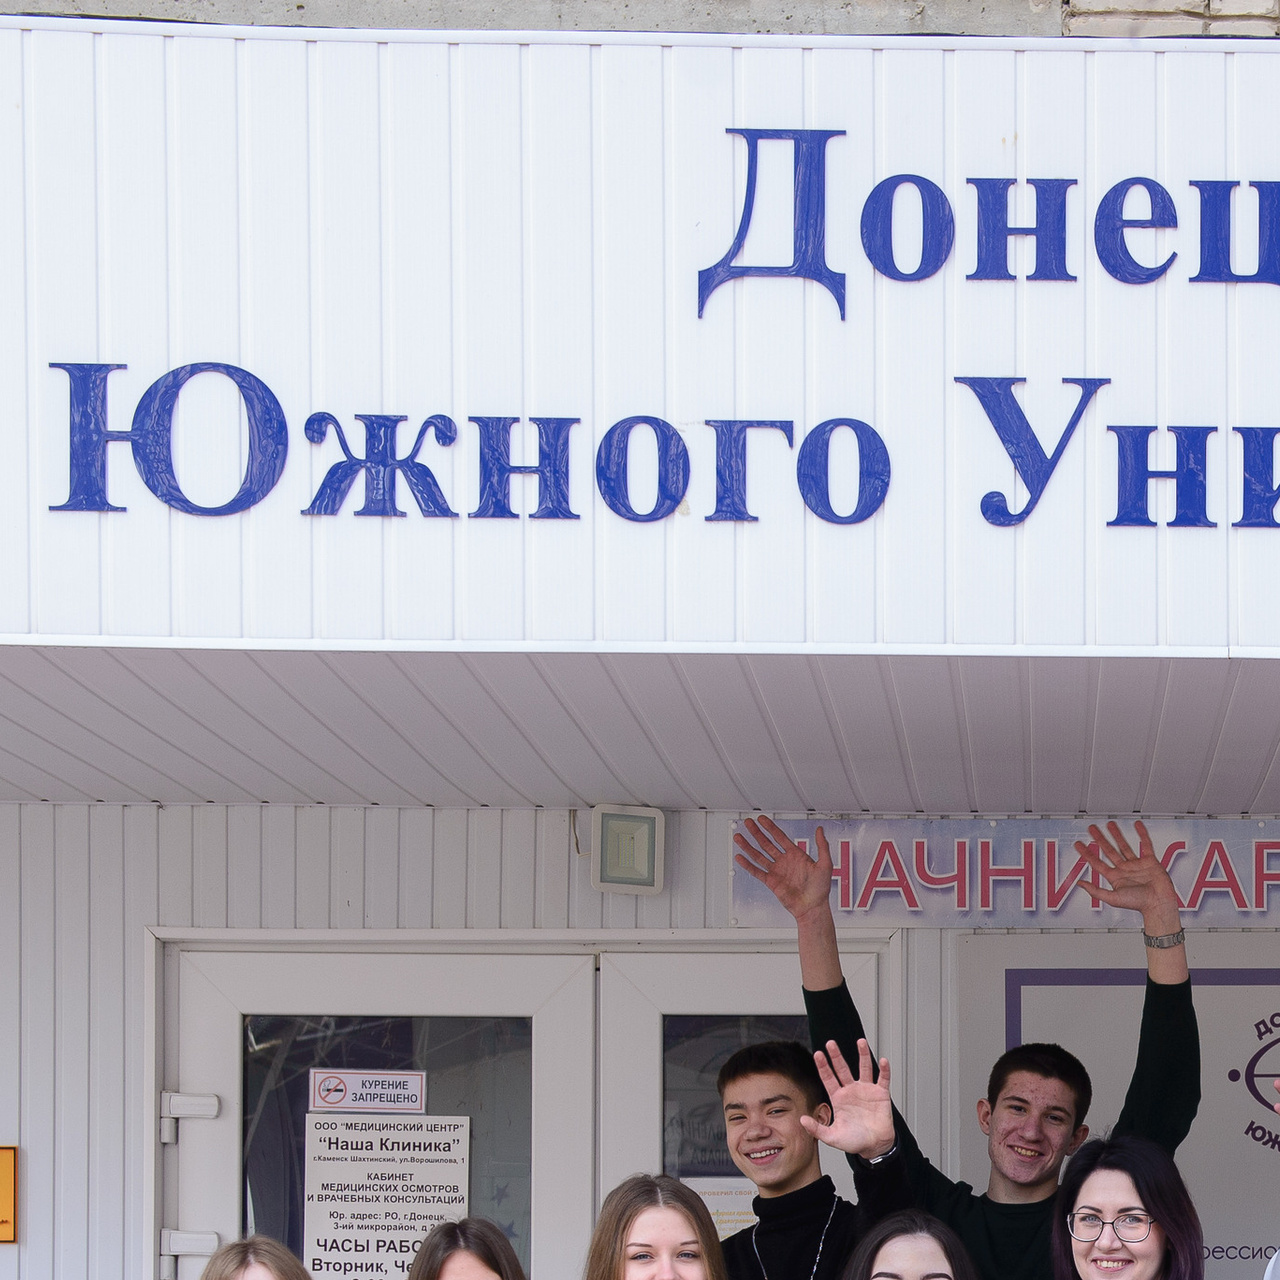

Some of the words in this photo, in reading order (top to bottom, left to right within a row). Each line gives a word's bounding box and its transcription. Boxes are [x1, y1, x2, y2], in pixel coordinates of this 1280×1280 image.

[48, 362, 891, 525] Южного
[361, 1080, 409, 1090] КУРЕНИЕ
[351, 1092, 418, 1104] ЗАПРЕЩЕНО
[314, 1122, 338, 1131] ООО
[367, 1173, 414, 1181] КАБИНЕТ
[321, 1183, 398, 1193] МЕДИЦИНСКИХ
[401, 1184, 459, 1193] ОСМОТРОВ
[307, 1194, 314, 1202] И
[317, 1194, 381, 1203] ВРАЧЕБНЫХ
[384, 1194, 465, 1205] КОНСУЛЬТАЦИЙ
[329, 1211, 347, 1221] Юр.
[350, 1212, 382, 1221] адрес:
[384, 1212, 401, 1221] РО,
[403, 1213, 447, 1222] г.Донецк,
[333, 1222, 354, 1231] 3-ий
[356, 1223, 418, 1232] микрорайон,
[316, 1238, 370, 1253] ЧАСЫ
[312, 1258, 388, 1275] Вторник,
